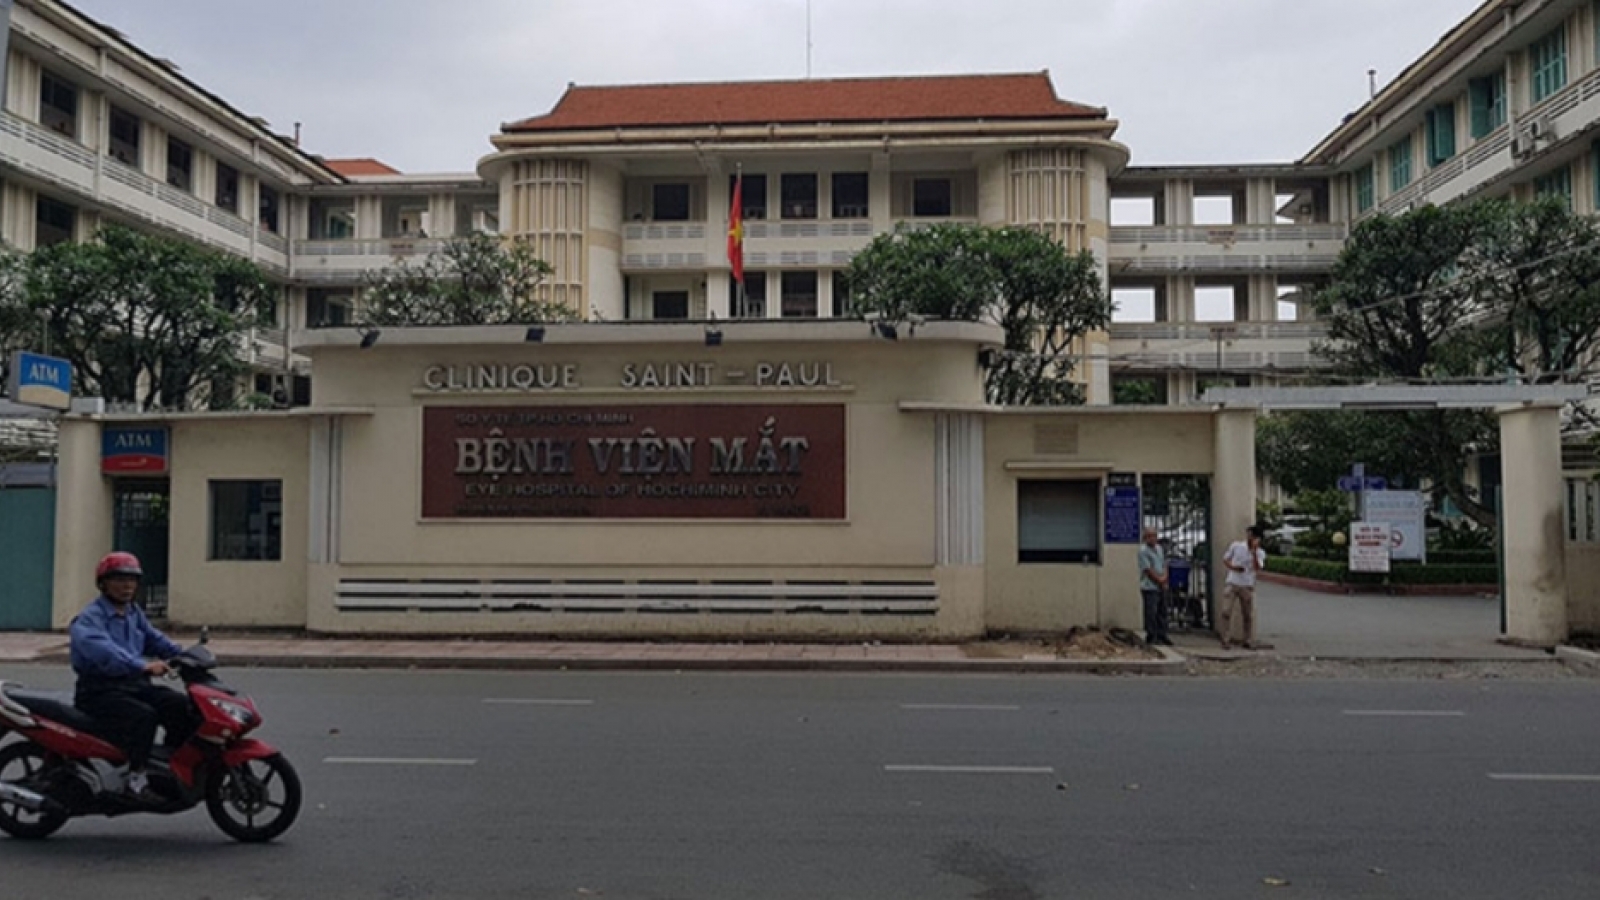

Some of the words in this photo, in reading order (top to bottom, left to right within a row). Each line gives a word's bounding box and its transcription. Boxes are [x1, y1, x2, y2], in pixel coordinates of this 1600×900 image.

[29, 362, 60, 384] ATM
[424, 364, 581, 391] CLINIQUE
[620, 362, 716, 388] SAINT
[755, 362, 841, 387] PAUL
[115, 433, 152, 448] ATM
[454, 427, 575, 481] BỆNH
[587, 427, 695, 480] VIỆN
[708, 416, 810, 476] MẮT
[465, 483, 501, 498] EYE
[507, 483, 599, 498] HOSPITAL
[606, 483, 631, 498] OF
[636, 483, 747, 498] HOCHIMINH
[753, 483, 799, 498] CITY
